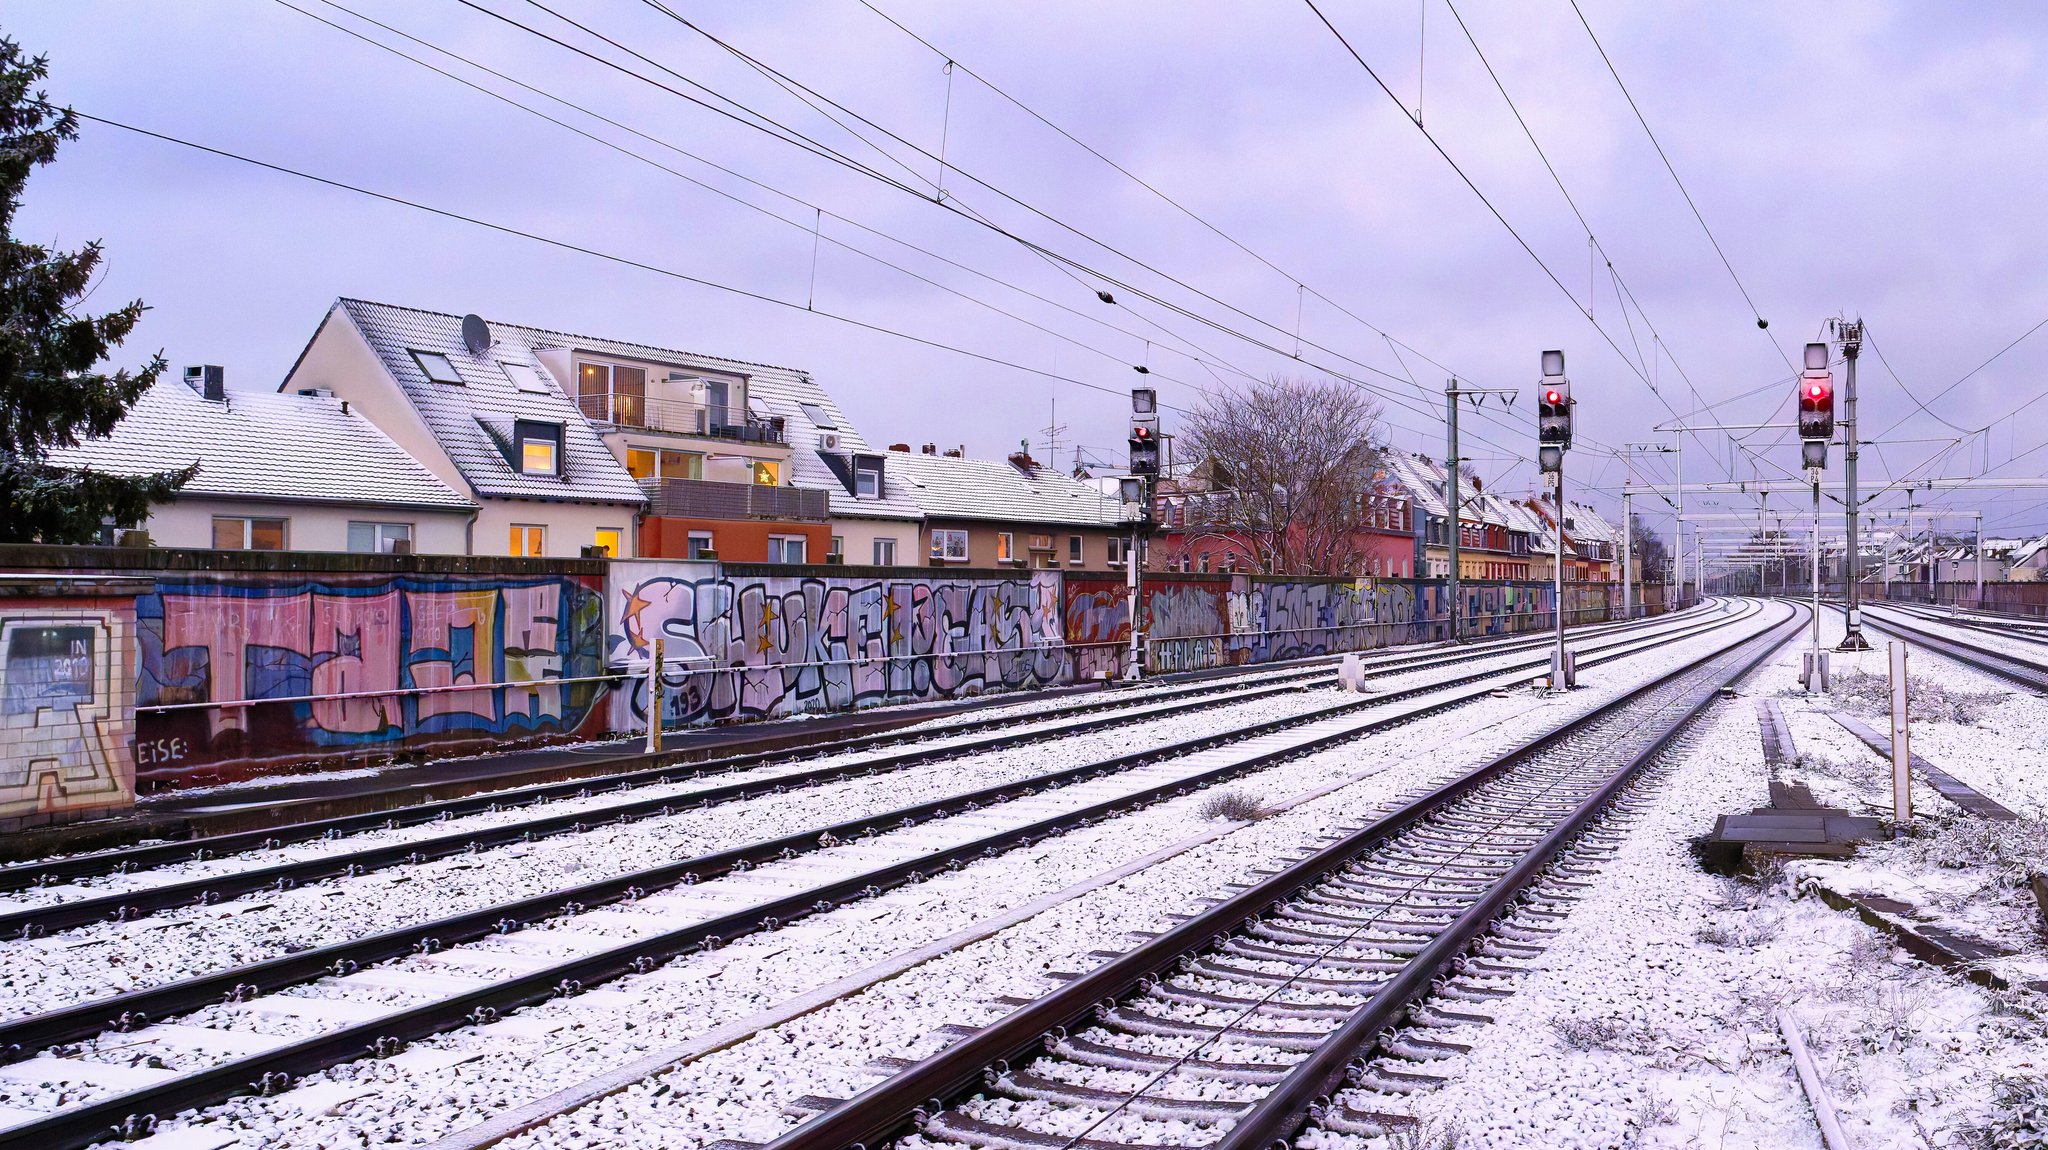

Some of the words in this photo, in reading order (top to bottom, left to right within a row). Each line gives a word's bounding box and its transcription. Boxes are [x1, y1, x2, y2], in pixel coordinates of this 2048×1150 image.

[1810, 467, 1819, 475] 36
[1810, 475, 1819, 484] P4
[71, 638, 87, 655] IN
